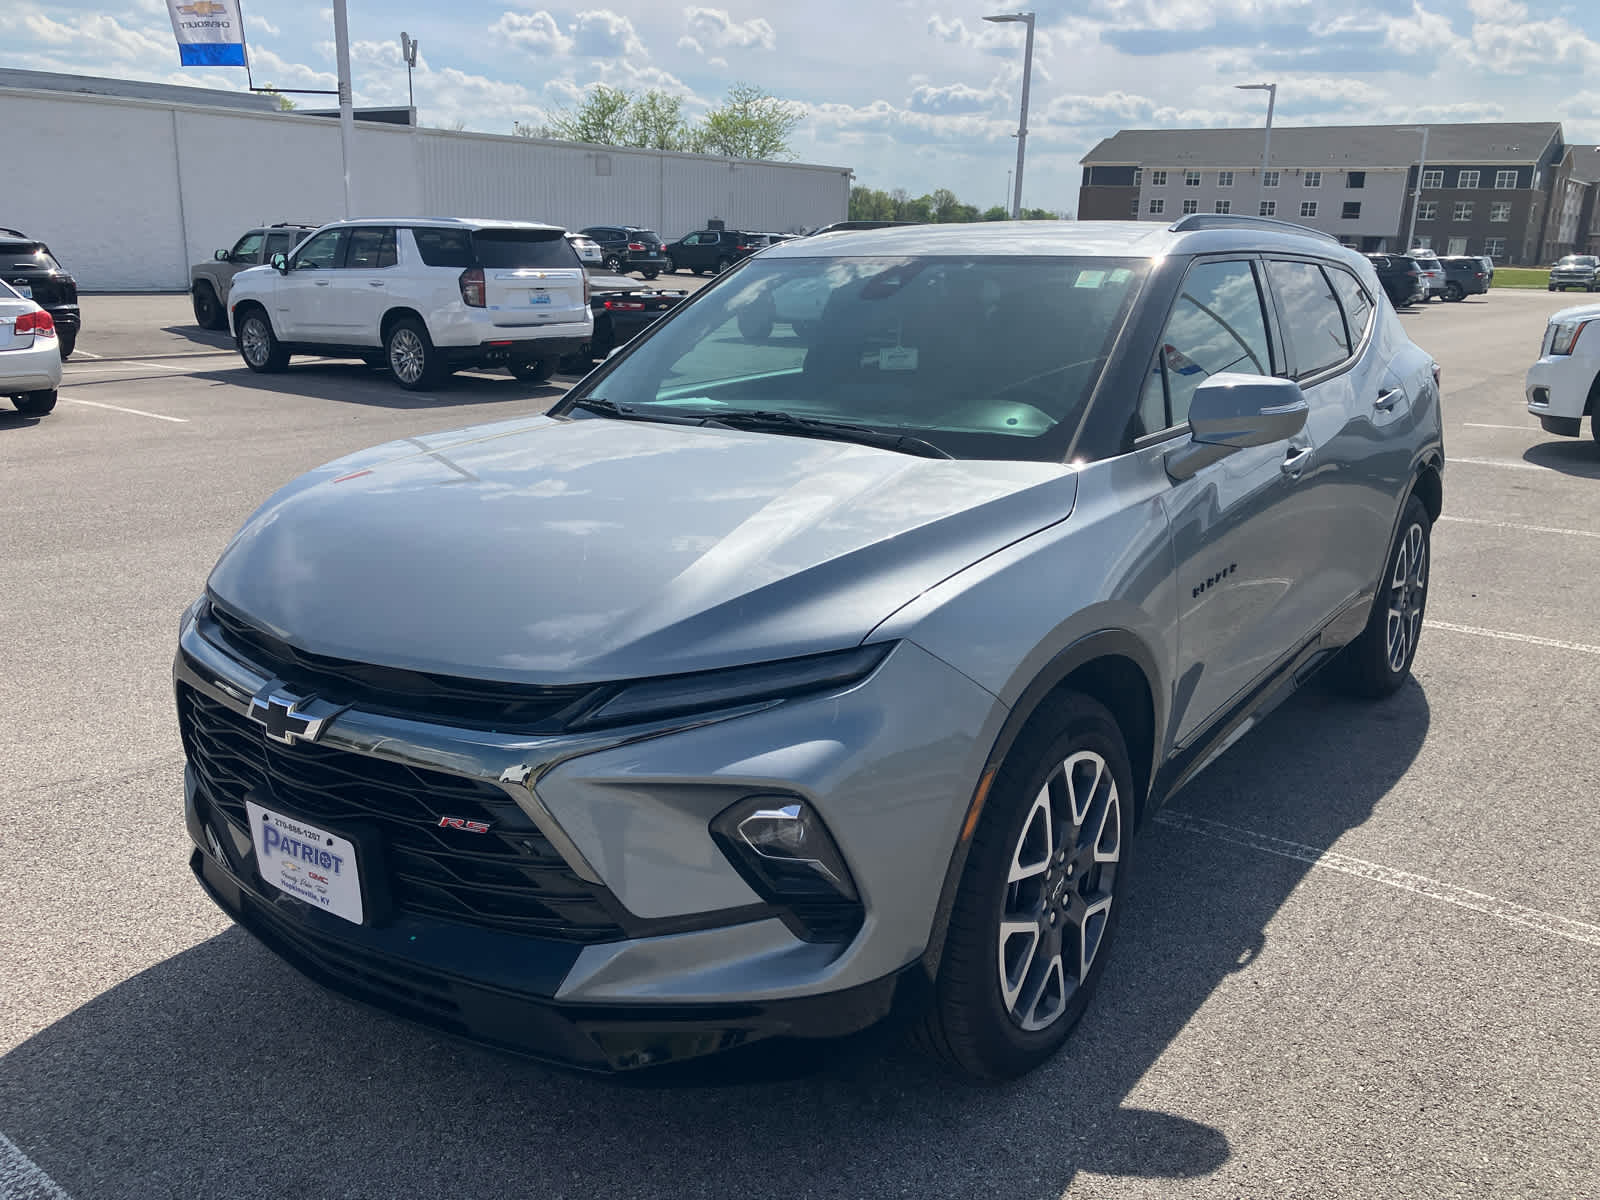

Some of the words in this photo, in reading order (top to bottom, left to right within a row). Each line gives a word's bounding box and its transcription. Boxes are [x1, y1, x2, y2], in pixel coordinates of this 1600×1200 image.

[438, 816, 490, 833] RS
[263, 824, 343, 874] PATRIOT
[308, 871, 329, 885] GMC
[320, 896, 330, 906] KY
